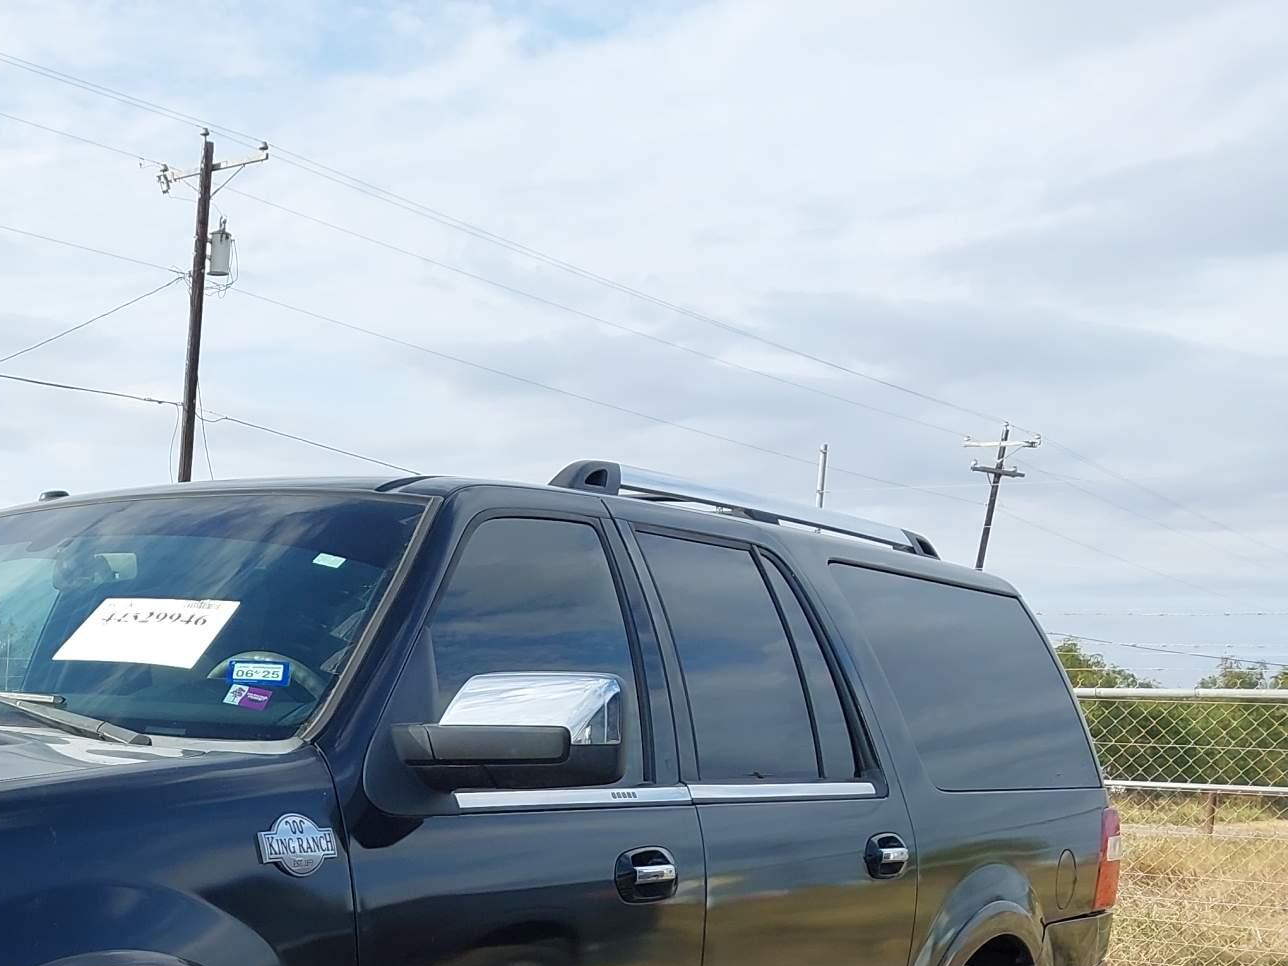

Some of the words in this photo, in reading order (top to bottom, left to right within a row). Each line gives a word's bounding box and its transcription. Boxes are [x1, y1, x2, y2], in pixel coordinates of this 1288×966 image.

[235, 669, 254, 678] 06
[261, 670, 280, 679] 25
[266, 836, 295, 855] KING
[296, 833, 335, 853] RANCH
